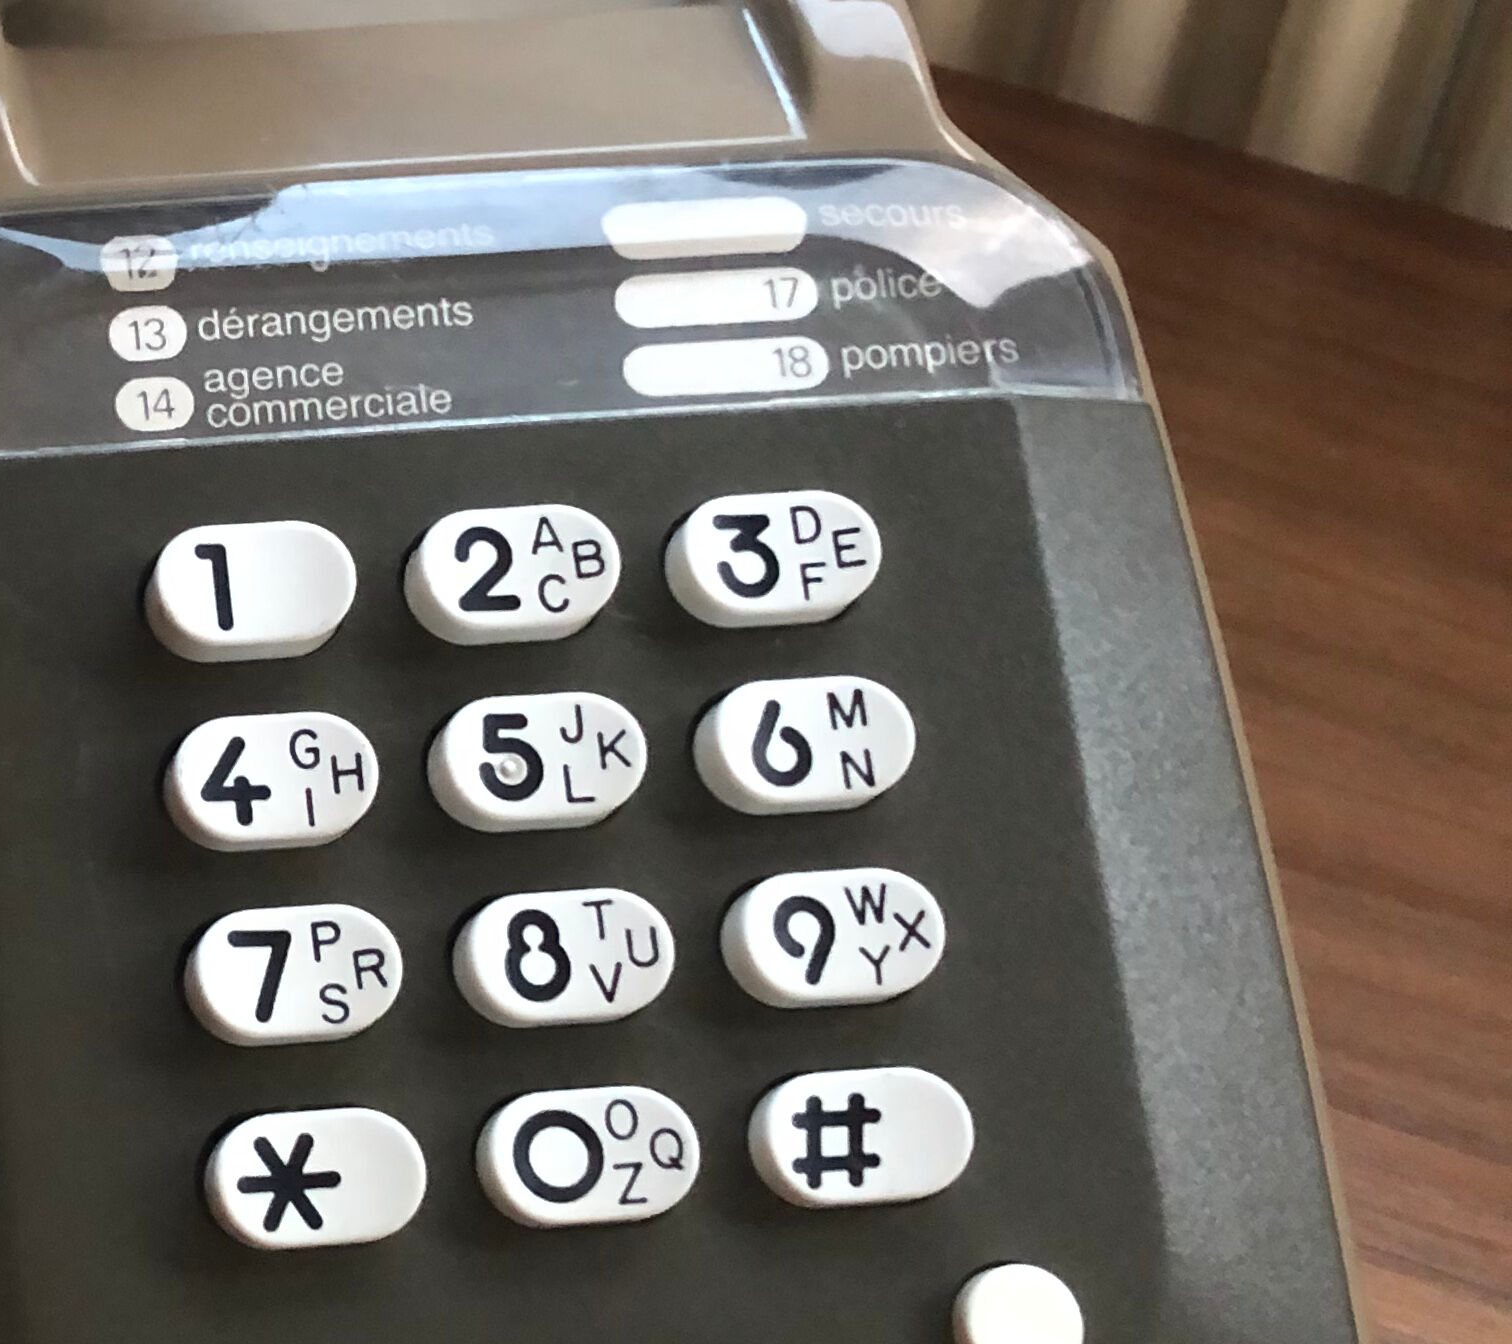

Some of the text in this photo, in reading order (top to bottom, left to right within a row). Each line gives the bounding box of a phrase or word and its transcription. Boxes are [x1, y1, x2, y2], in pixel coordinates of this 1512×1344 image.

[120, 223, 495, 280] 12 renseignements
[819, 202, 965, 227] secours
[127, 298, 474, 351] 13 dérangements
[763, 267, 942, 311] 17 police
[136, 360, 344, 421] 14 agence
[772, 334, 1019, 379] 18 pompiers
[206, 384, 452, 429] commerciale
[194, 543, 234, 631] 1
[454, 526, 522, 612] 2
[713, 514, 780, 598] 3
[200, 736, 272, 826] 4
[479, 713, 544, 802] 5
[752, 700, 813, 787] 6
[227, 930, 292, 1023] 7
[505, 909, 572, 1003] 8
[773, 895, 836, 985] 9
[512, 1109, 604, 1204] 0
[793, 1094, 881, 1189] #
